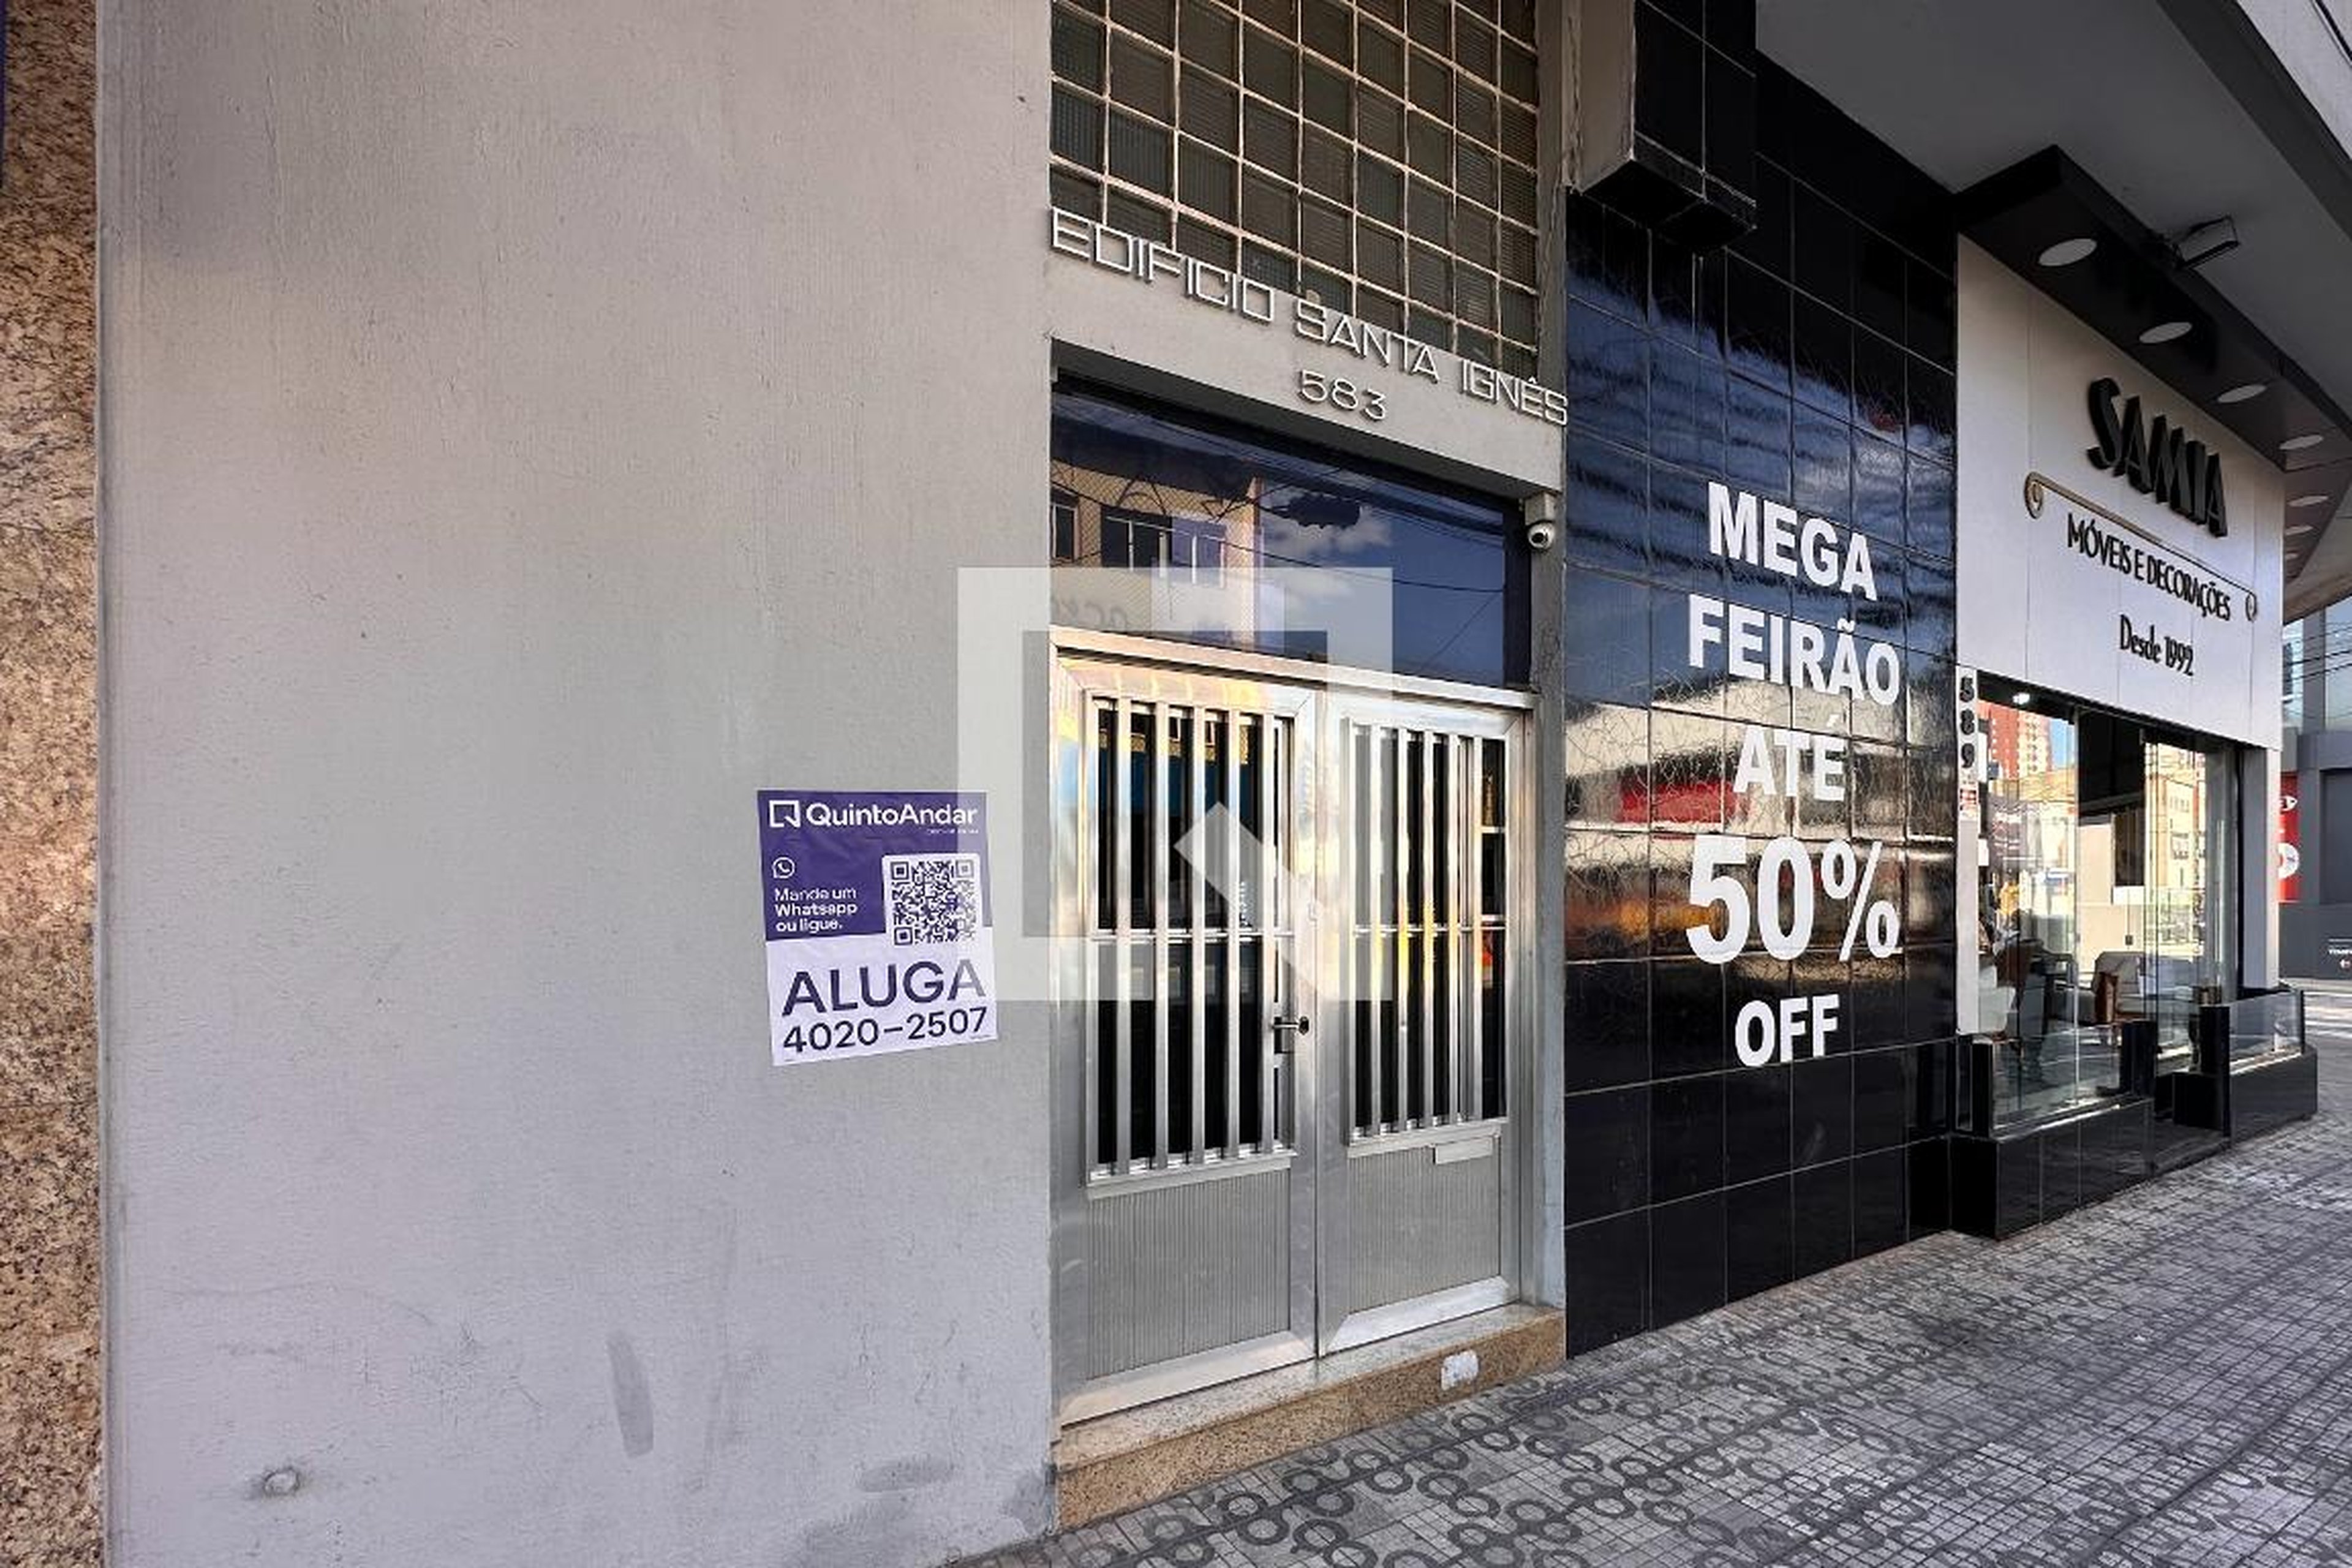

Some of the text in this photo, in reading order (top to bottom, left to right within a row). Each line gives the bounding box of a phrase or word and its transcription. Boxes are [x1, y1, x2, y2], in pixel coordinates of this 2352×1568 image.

[1051, 206, 1569, 426] EDIFICIO SANTA IGNÊS
[1298, 369, 1387, 421] 583
[2086, 377, 2228, 537] SAMIA
[1708, 481, 1877, 601] MEGA
[2067, 512, 2231, 621] MÓVEIS E DECORAÇÕES
[1688, 594, 1900, 706] FEIRÃO
[2119, 613, 2194, 676] Desde 1992
[1733, 714, 1846, 802] ATÉ
[1959, 676, 1975, 769] 589
[805, 801, 978, 827] QuintoAndar
[774, 902, 858, 918] Whatsapp
[775, 918, 843, 934] ou ligue.
[832, 888, 857, 900] um
[1686, 834, 1903, 965] 50%
[782, 959, 987, 1017] ALUGA
[783, 1006, 988, 1054] 4020-2507
[1735, 993, 1839, 1067] OFF
